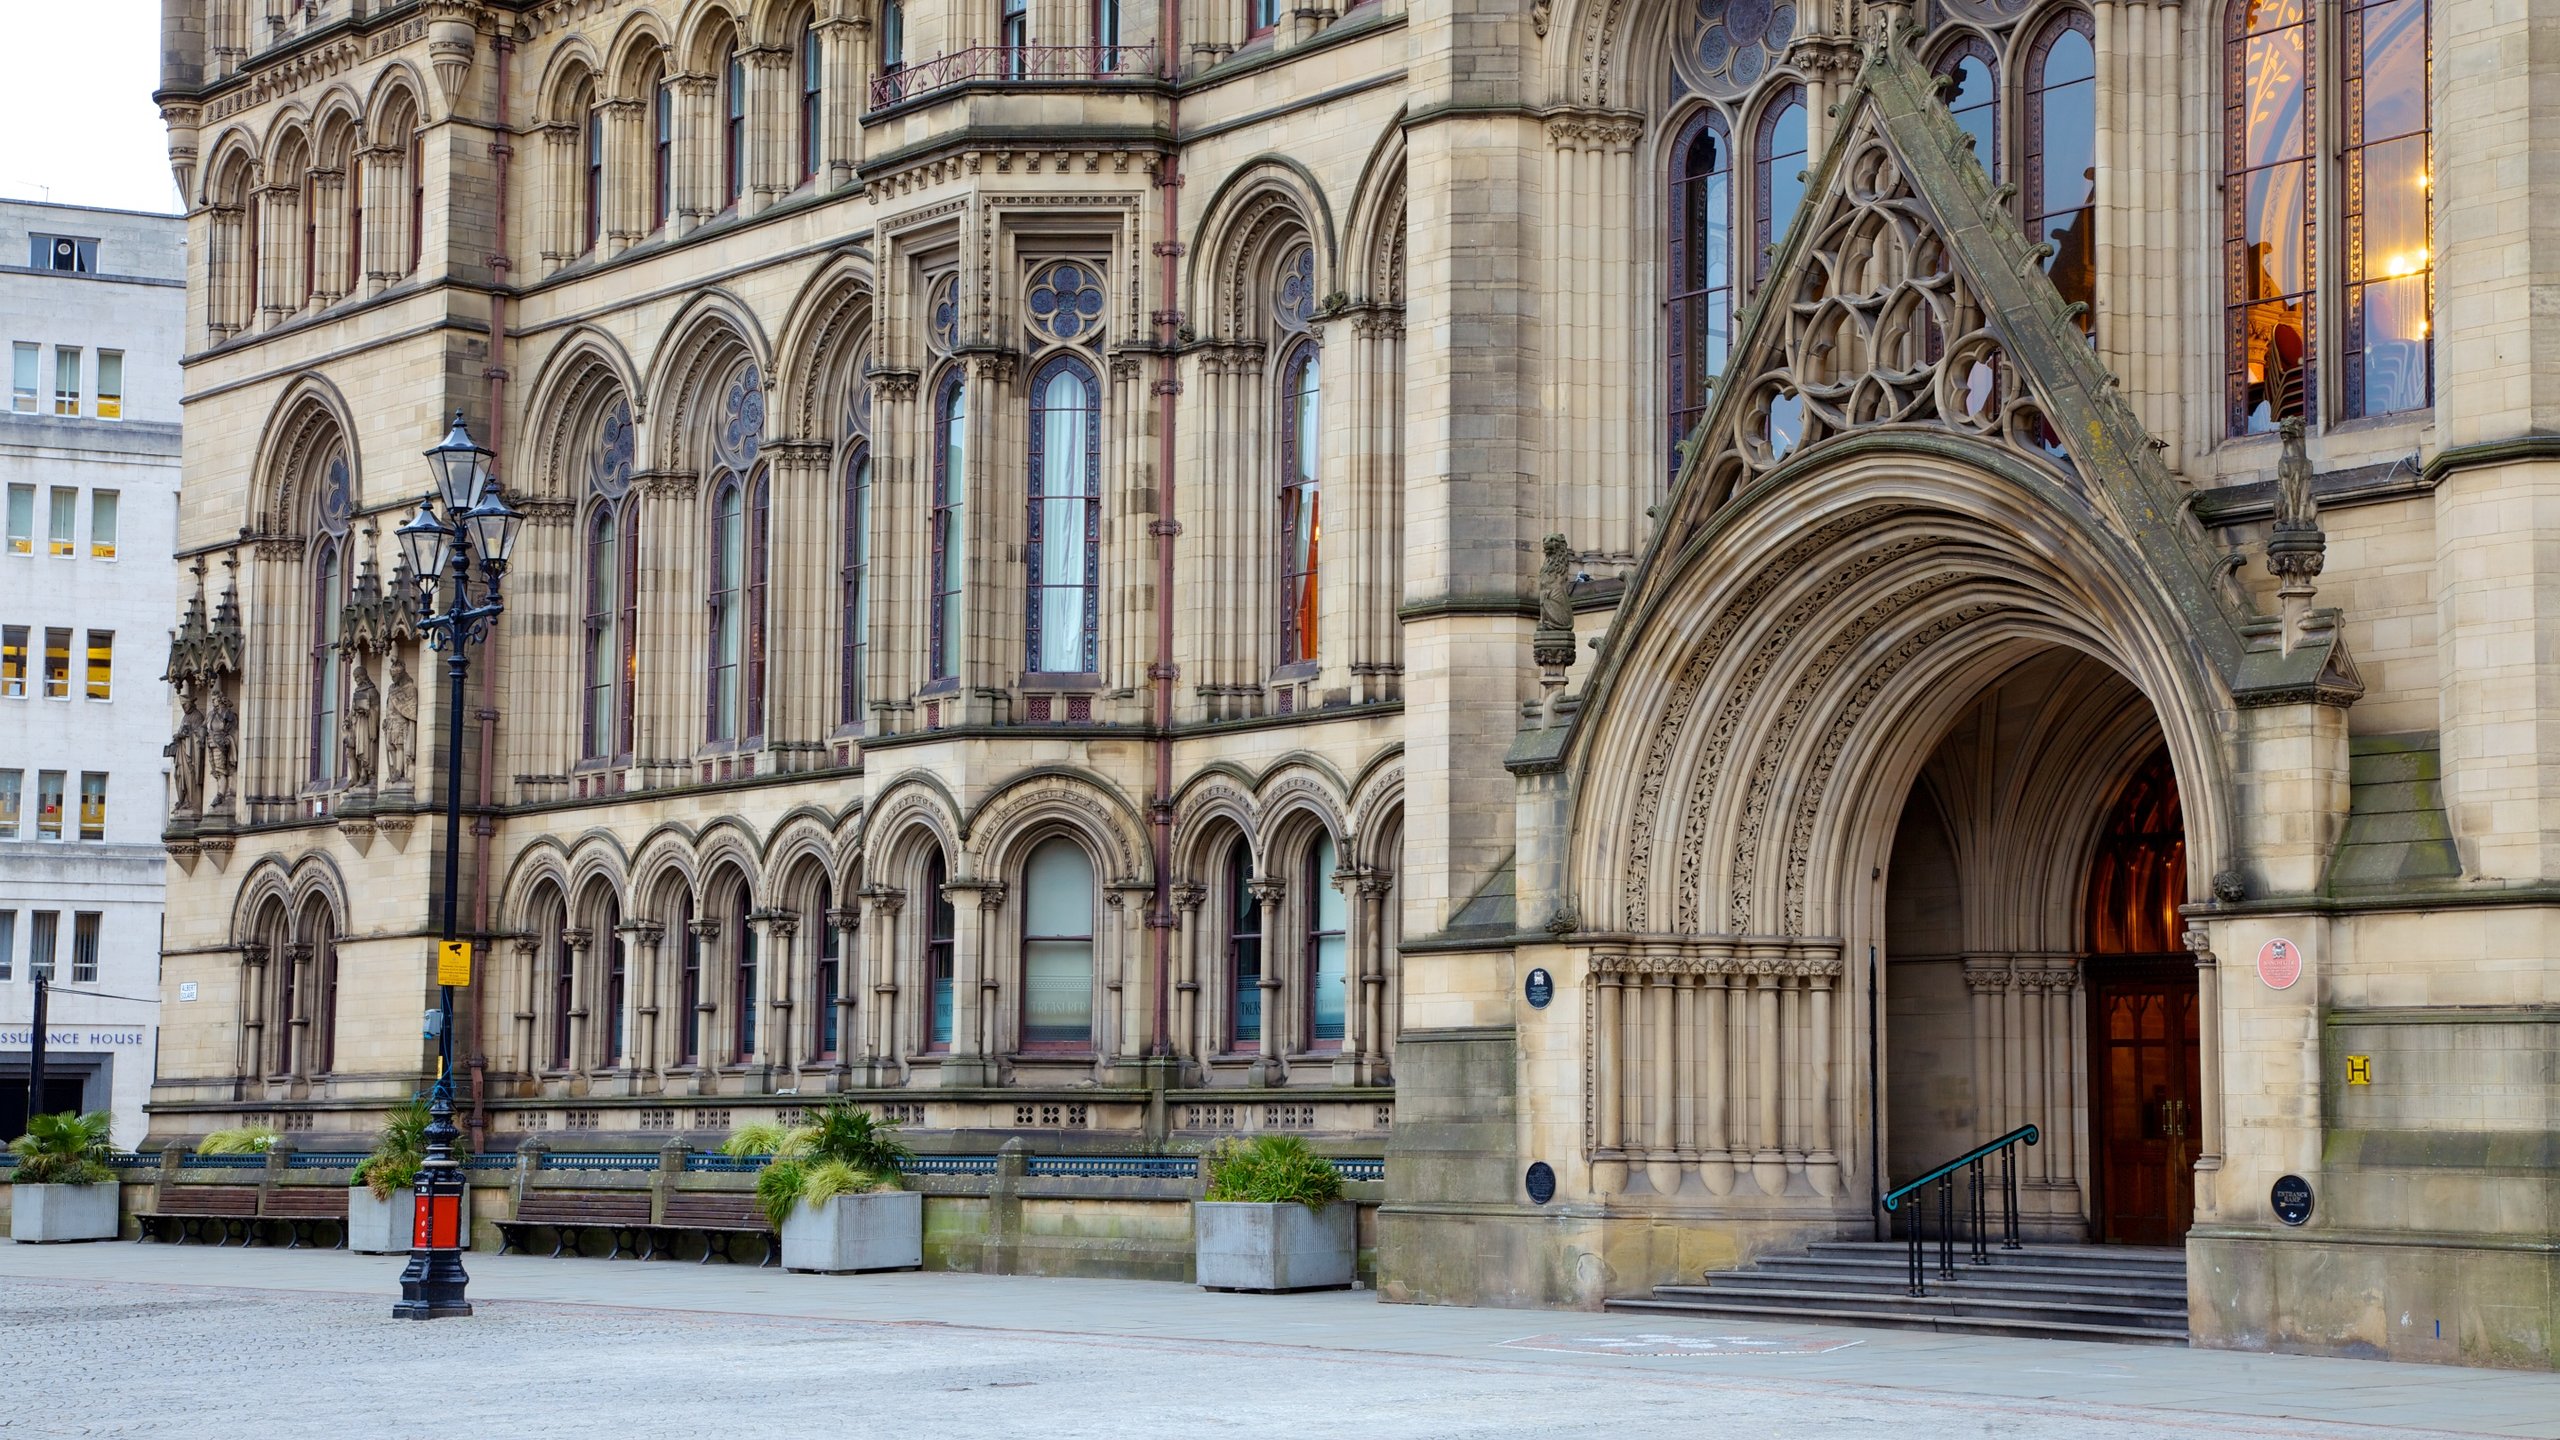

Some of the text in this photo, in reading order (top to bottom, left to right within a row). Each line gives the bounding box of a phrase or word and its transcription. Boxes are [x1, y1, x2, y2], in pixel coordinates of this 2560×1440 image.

[1031, 1001, 1087, 1016] TREASURER
[1, 1032, 143, 1045] SSUNCE HOUSE
